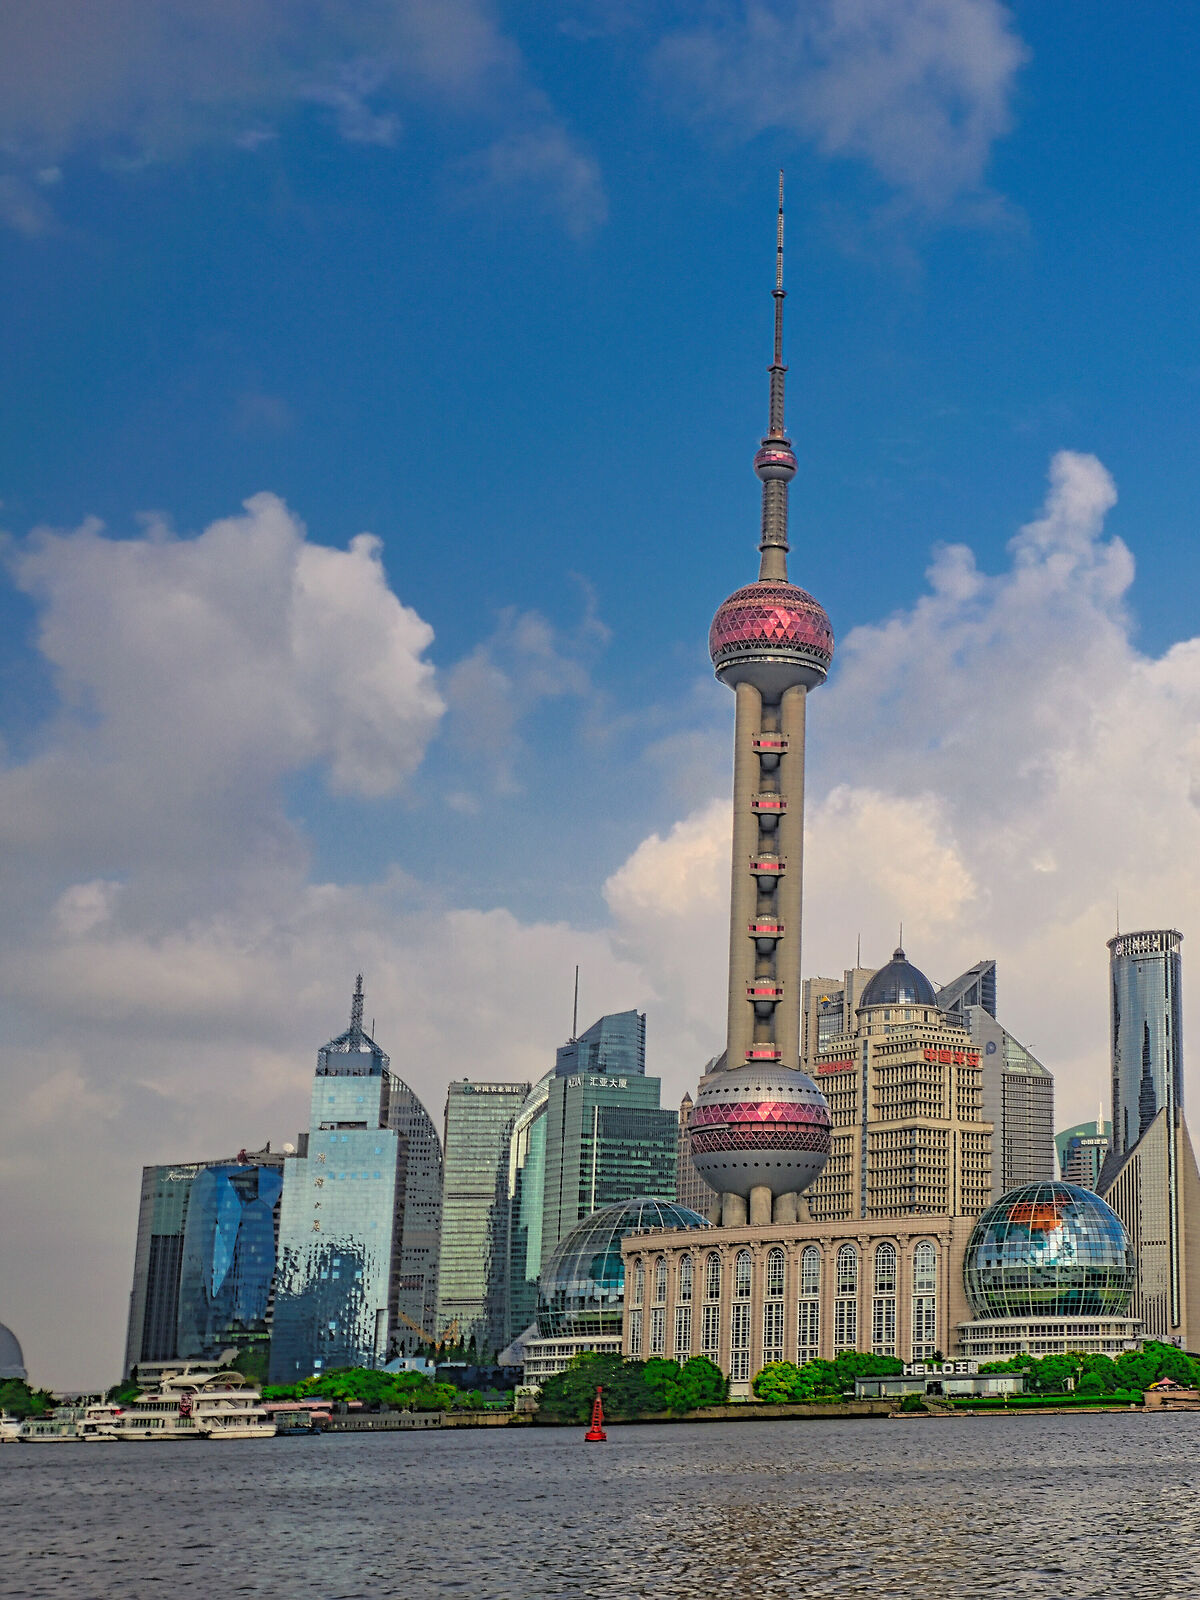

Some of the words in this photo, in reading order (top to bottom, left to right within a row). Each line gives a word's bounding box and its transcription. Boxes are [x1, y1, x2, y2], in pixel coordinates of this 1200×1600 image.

[924, 1048, 980, 1067] 中国平安
[590, 1076, 628, 1089] 汇亚大厦
